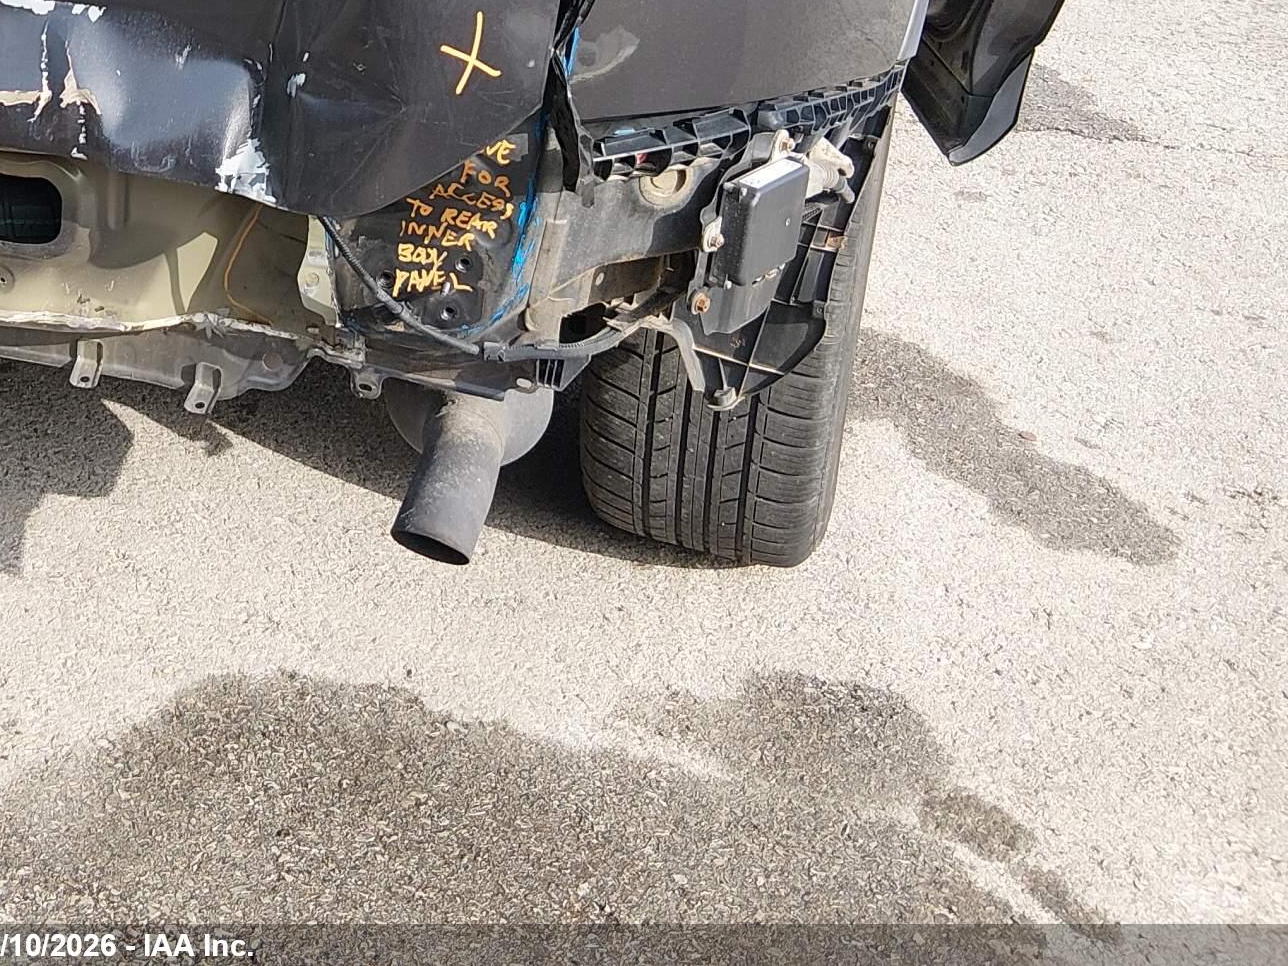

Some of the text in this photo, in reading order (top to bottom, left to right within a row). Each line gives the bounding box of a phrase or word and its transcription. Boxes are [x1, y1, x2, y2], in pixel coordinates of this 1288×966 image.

[460, 159, 511, 197] FOR
[399, 220, 476, 251] INNER
[440, 207, 498, 239] REAR
[397, 243, 448, 270] BODY
[392, 268, 474, 298] PANEL
